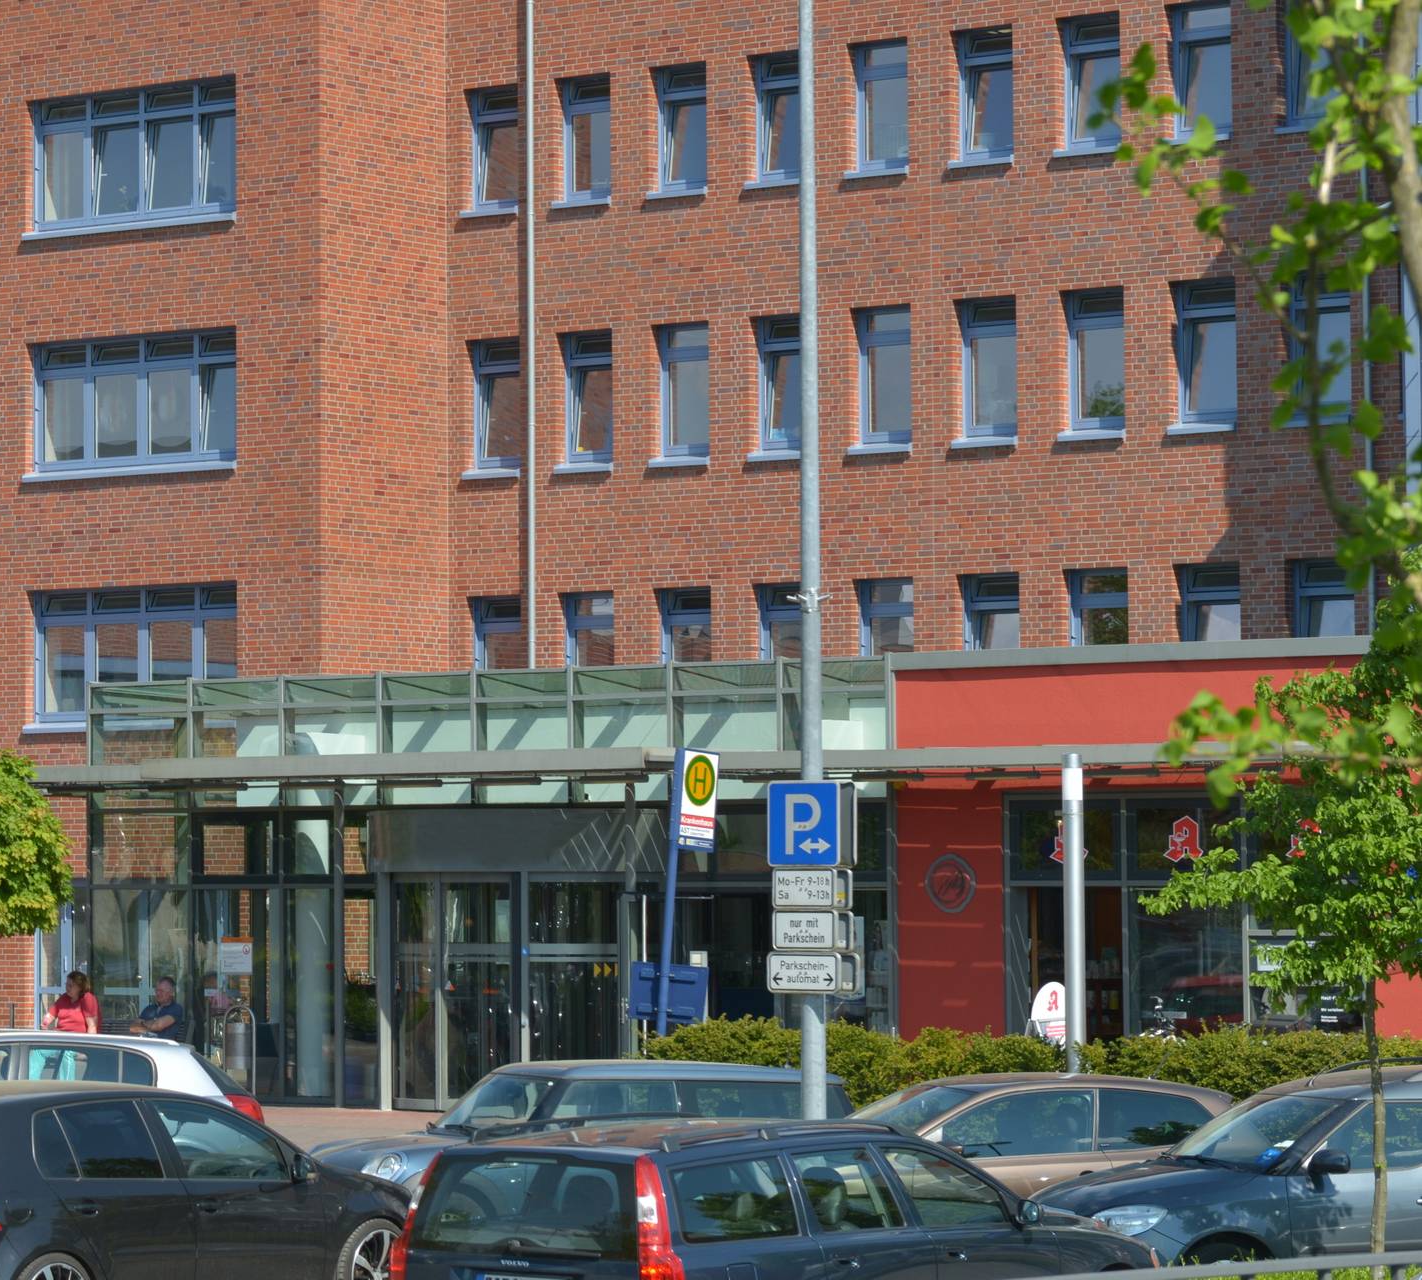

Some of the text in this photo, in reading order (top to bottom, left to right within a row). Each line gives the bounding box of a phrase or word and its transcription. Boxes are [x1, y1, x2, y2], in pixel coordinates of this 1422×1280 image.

[693, 766, 707, 796] H
[785, 793, 822, 855] P
[778, 876, 804, 886] Mo-Fr
[778, 890, 830, 900] Sa 9-13h
[789, 917, 819, 928] nur mit
[783, 932, 825, 943] Parkschein
[787, 975, 820, 984] automat
[500, 1259, 530, 1268] VOLVO
